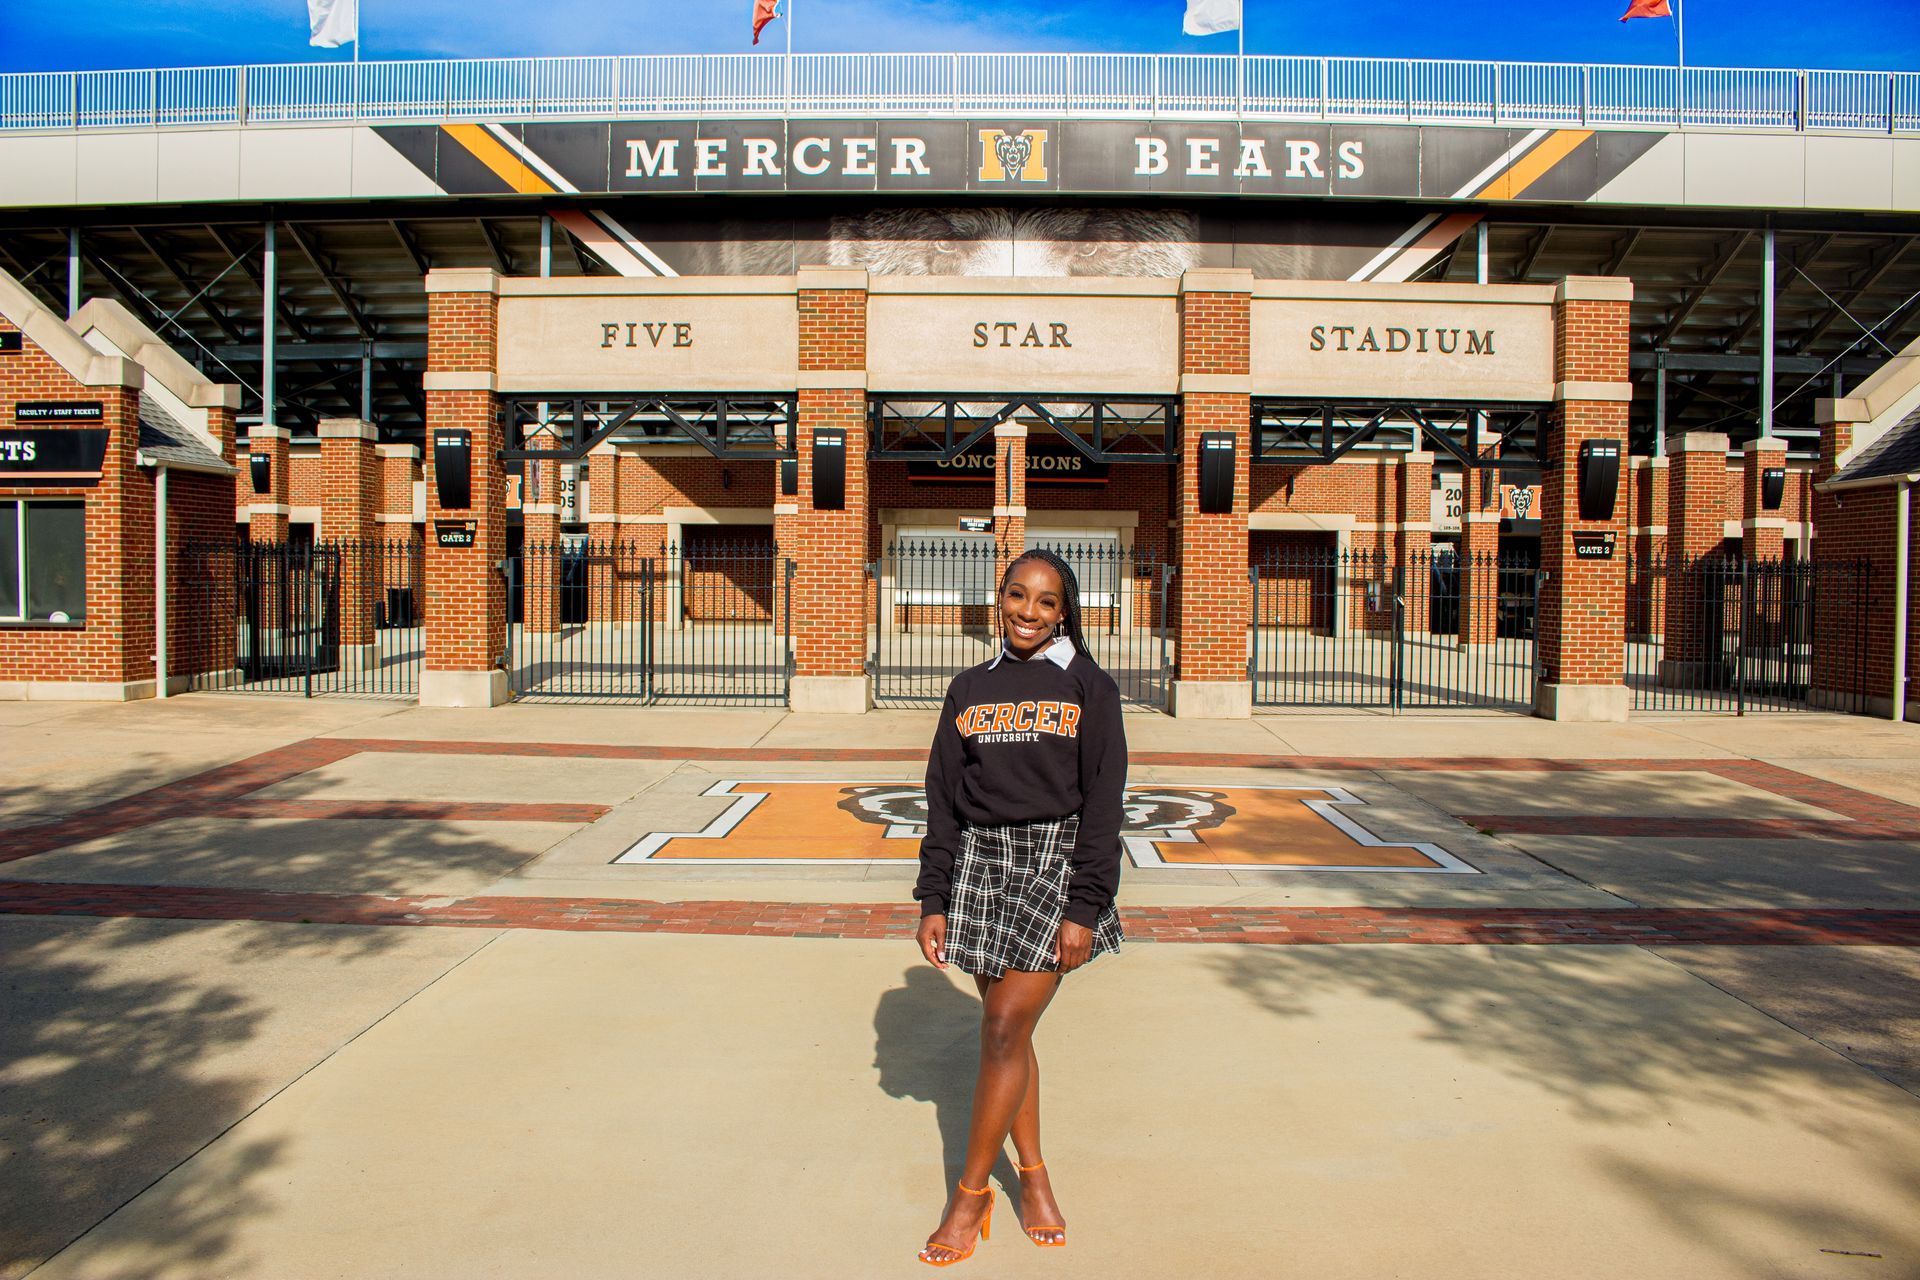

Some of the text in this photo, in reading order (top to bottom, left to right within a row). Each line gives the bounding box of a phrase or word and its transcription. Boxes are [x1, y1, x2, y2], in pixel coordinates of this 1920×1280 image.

[625, 138, 931, 177] MERCER
[1134, 137, 1365, 179] BEARS
[601, 321, 1496, 356] FIVE STAR STADIUM
[937, 454, 1082, 470] CONCSIONS
[560, 479, 576, 492] 05
[1445, 488, 1463, 501] 20
[560, 495, 576, 508] 05
[1446, 505, 1462, 518] 10
[441, 534, 464, 542] GATE
[1578, 545, 1611, 555] GATE 2
[956, 701, 1082, 740] MERCER
[978, 733, 1040, 744] UNIVERSITY
